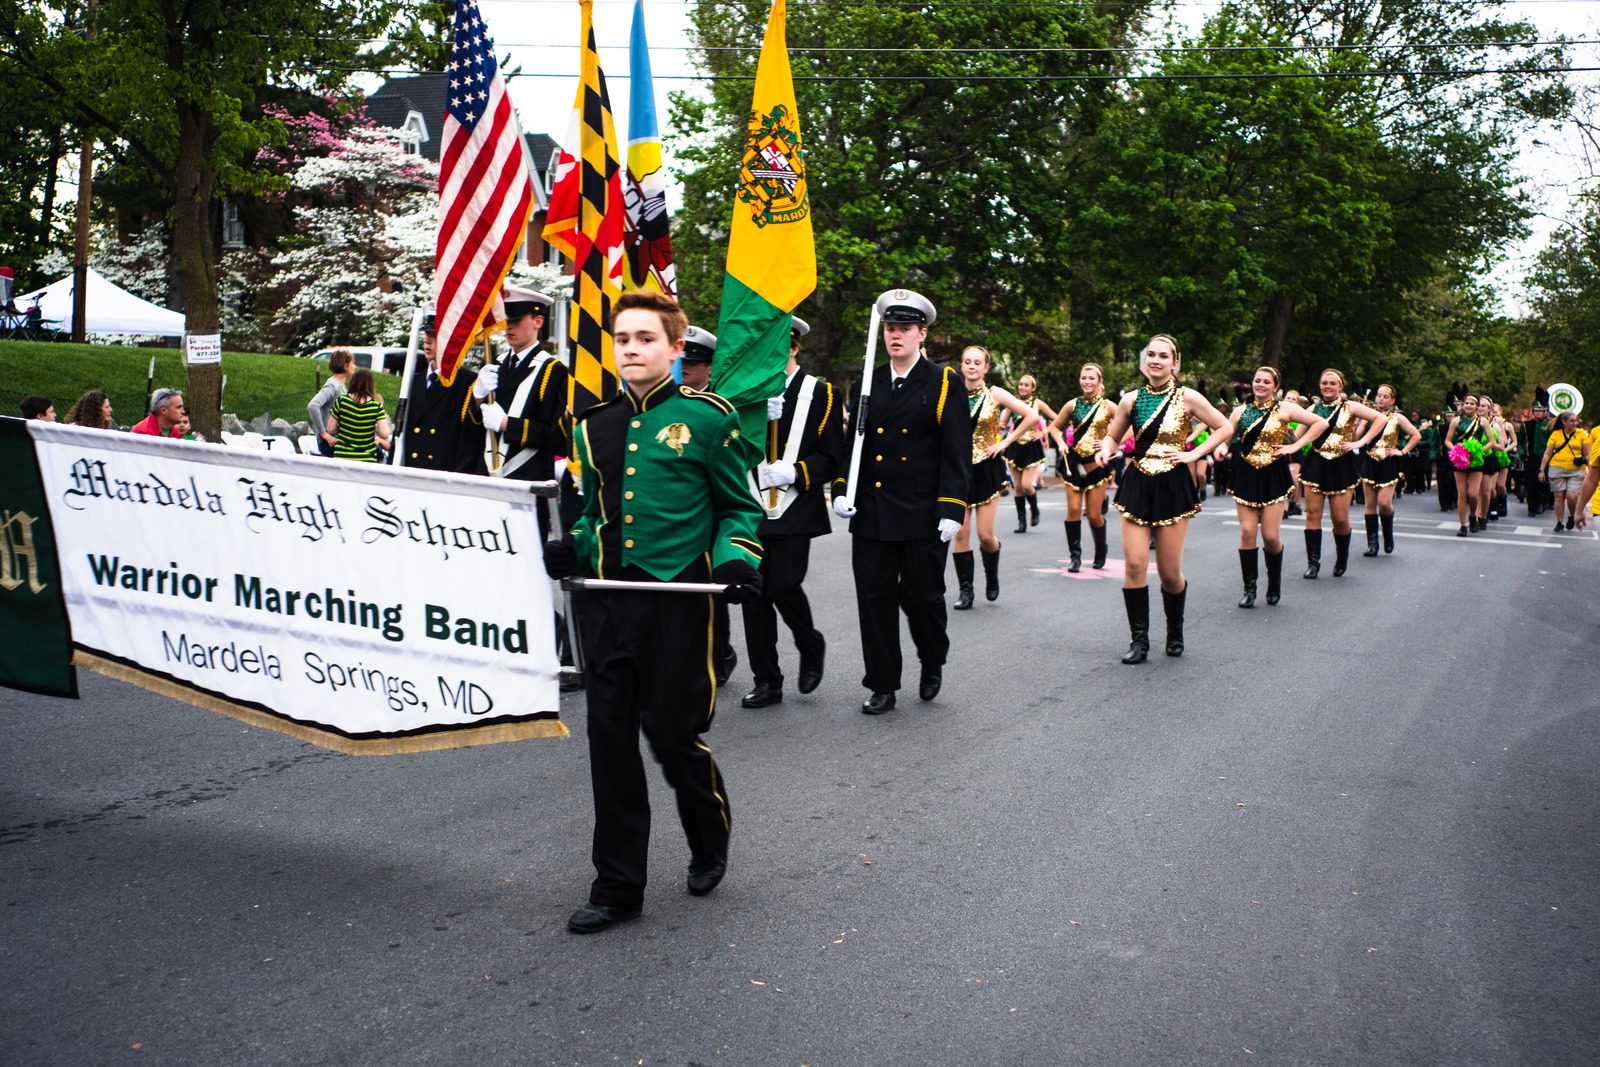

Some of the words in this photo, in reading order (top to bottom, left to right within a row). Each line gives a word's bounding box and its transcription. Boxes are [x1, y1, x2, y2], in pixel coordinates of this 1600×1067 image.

[62, 458, 227, 516] Mardela
[236, 477, 346, 544] High
[361, 496, 518, 560] School
[87, 553, 218, 602] Warrior
[234, 573, 404, 642] Marching
[425, 604, 529, 654] Band
[162, 630, 283, 681] Mardela
[304, 652, 428, 712] Springs,
[438, 676, 493, 715] MD
